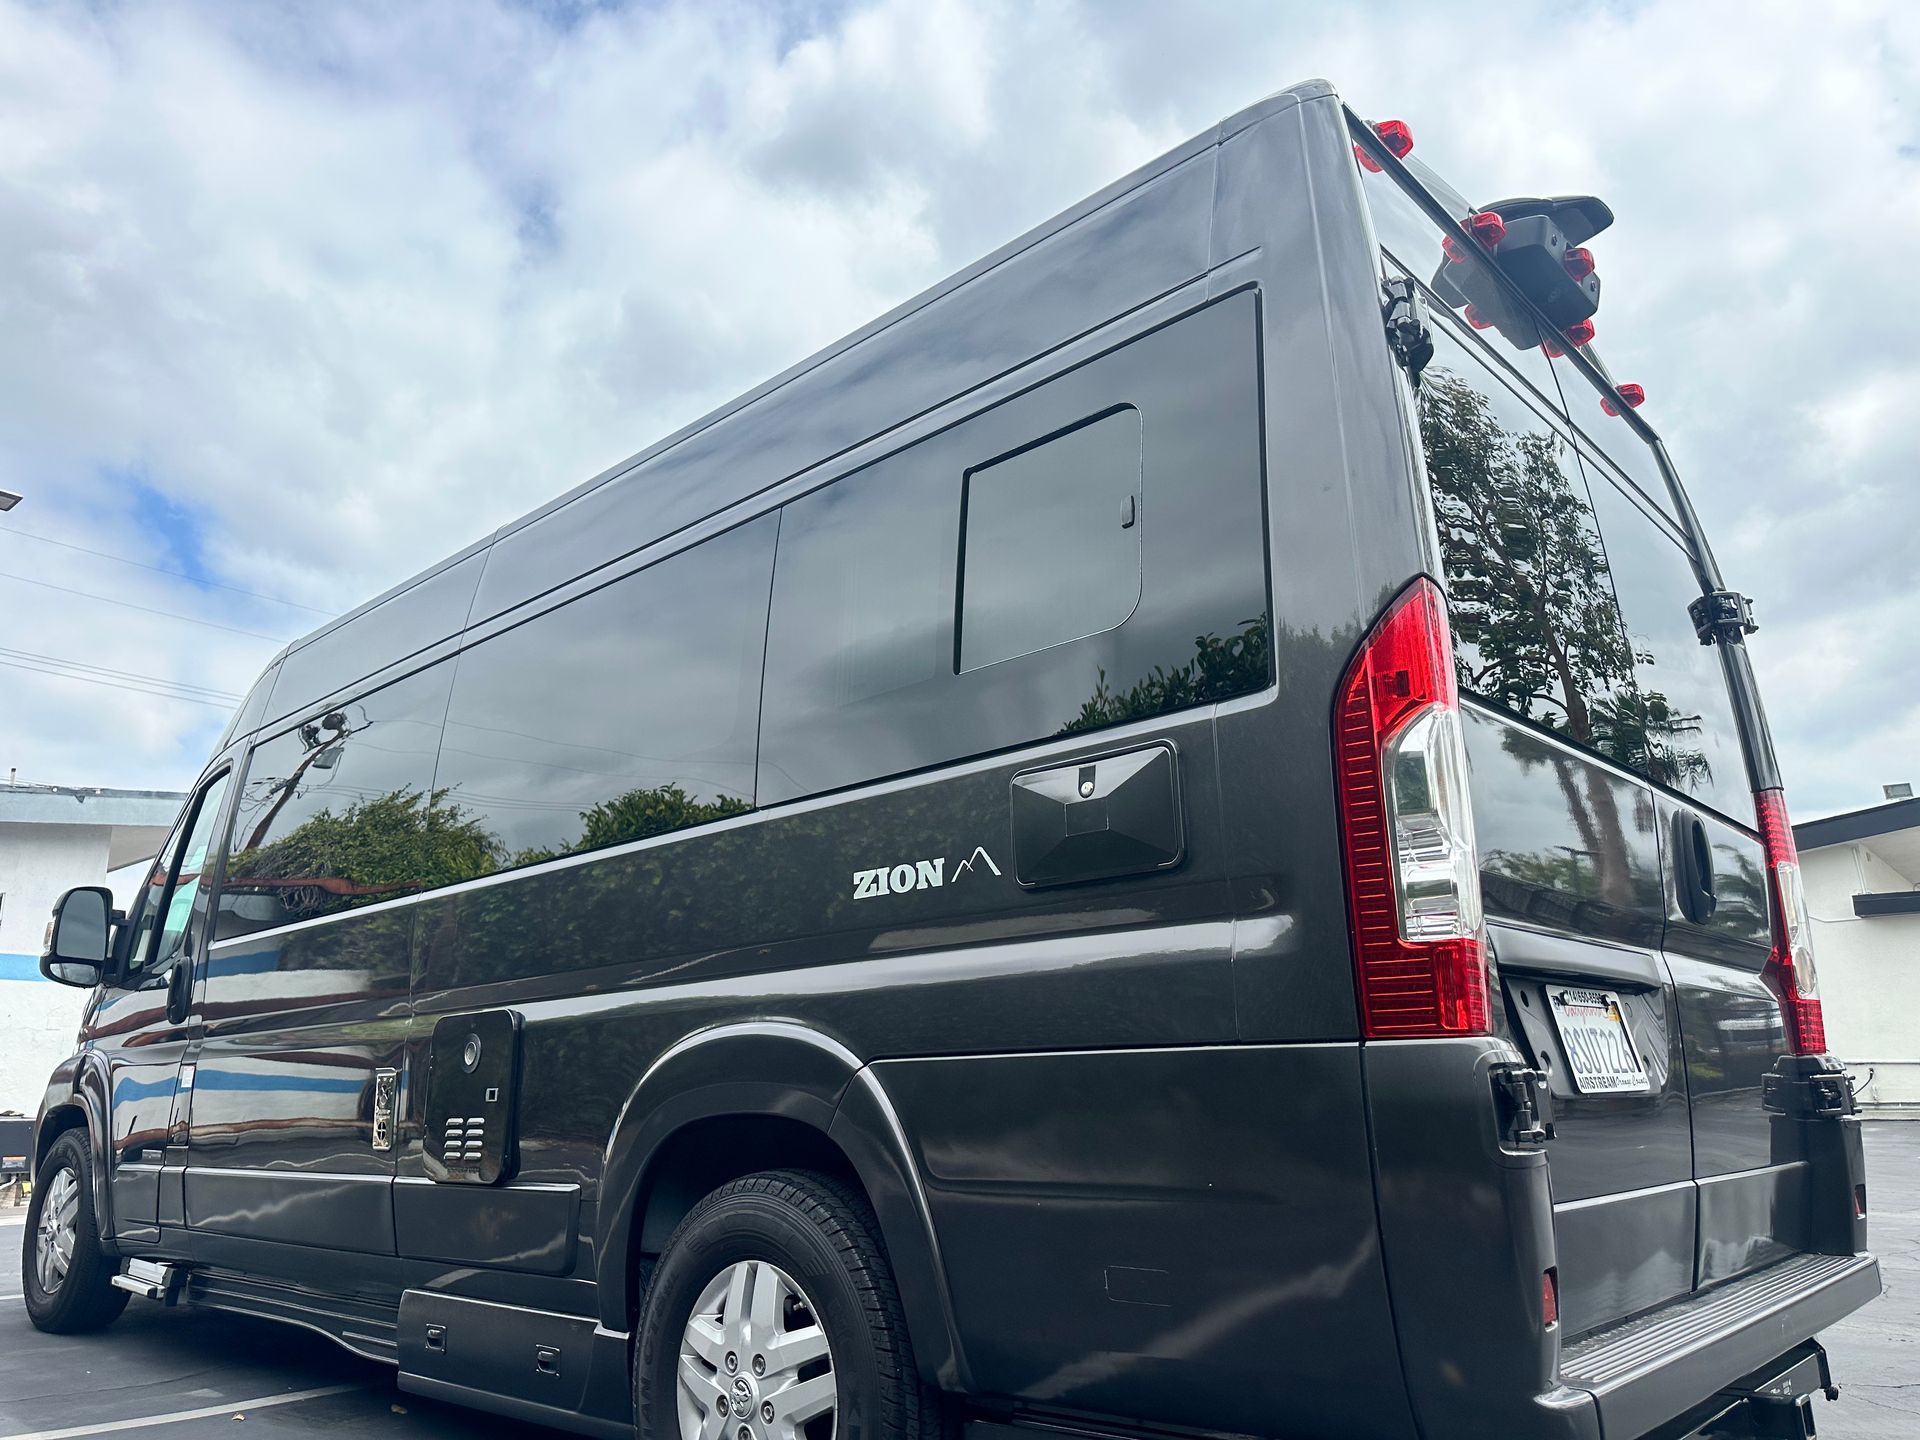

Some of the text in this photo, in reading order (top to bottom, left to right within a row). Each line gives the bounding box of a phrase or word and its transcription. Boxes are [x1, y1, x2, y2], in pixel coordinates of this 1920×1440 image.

[853, 857, 945, 900] ZION
[1563, 1025, 1636, 1073] 8SUT226
[1578, 1076, 1618, 1089] AIRSTREAM
